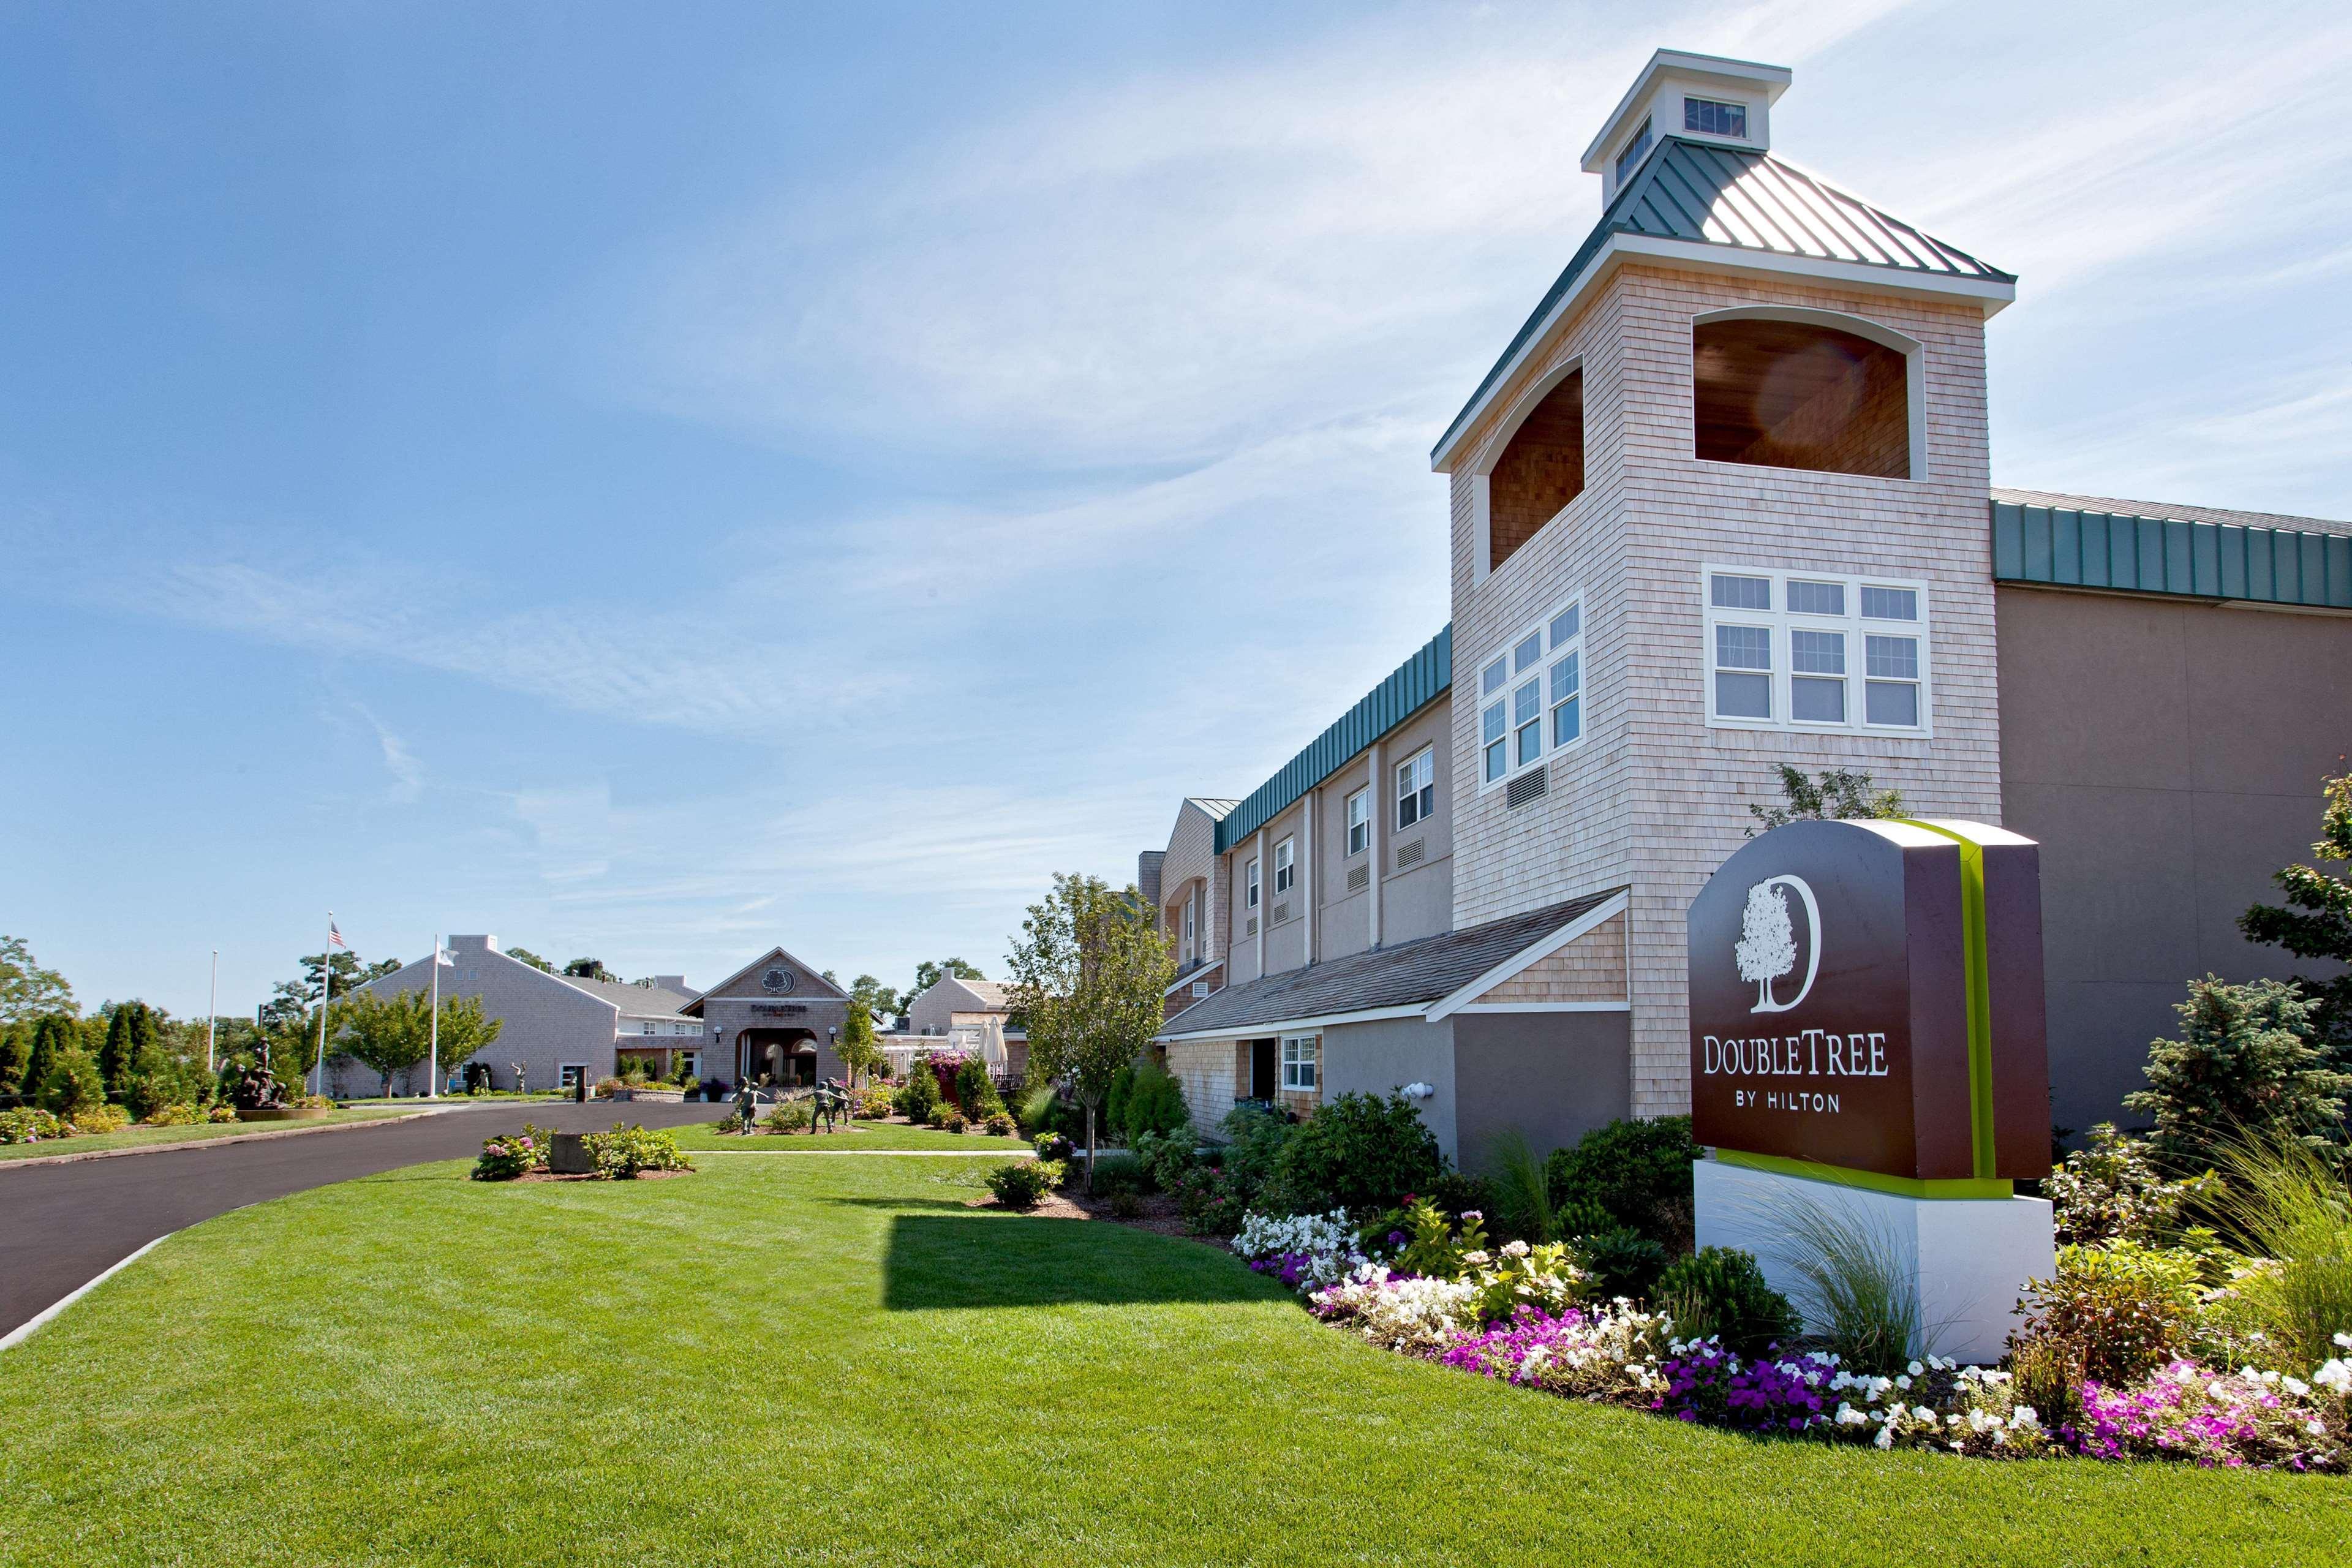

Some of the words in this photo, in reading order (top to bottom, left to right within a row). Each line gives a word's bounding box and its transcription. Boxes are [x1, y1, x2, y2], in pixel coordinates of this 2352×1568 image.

[1703, 1029, 1888, 1076] DOUBLETREE
[1736, 1090, 1756, 1107] BY
[1768, 1091, 1839, 1113] HILTON
